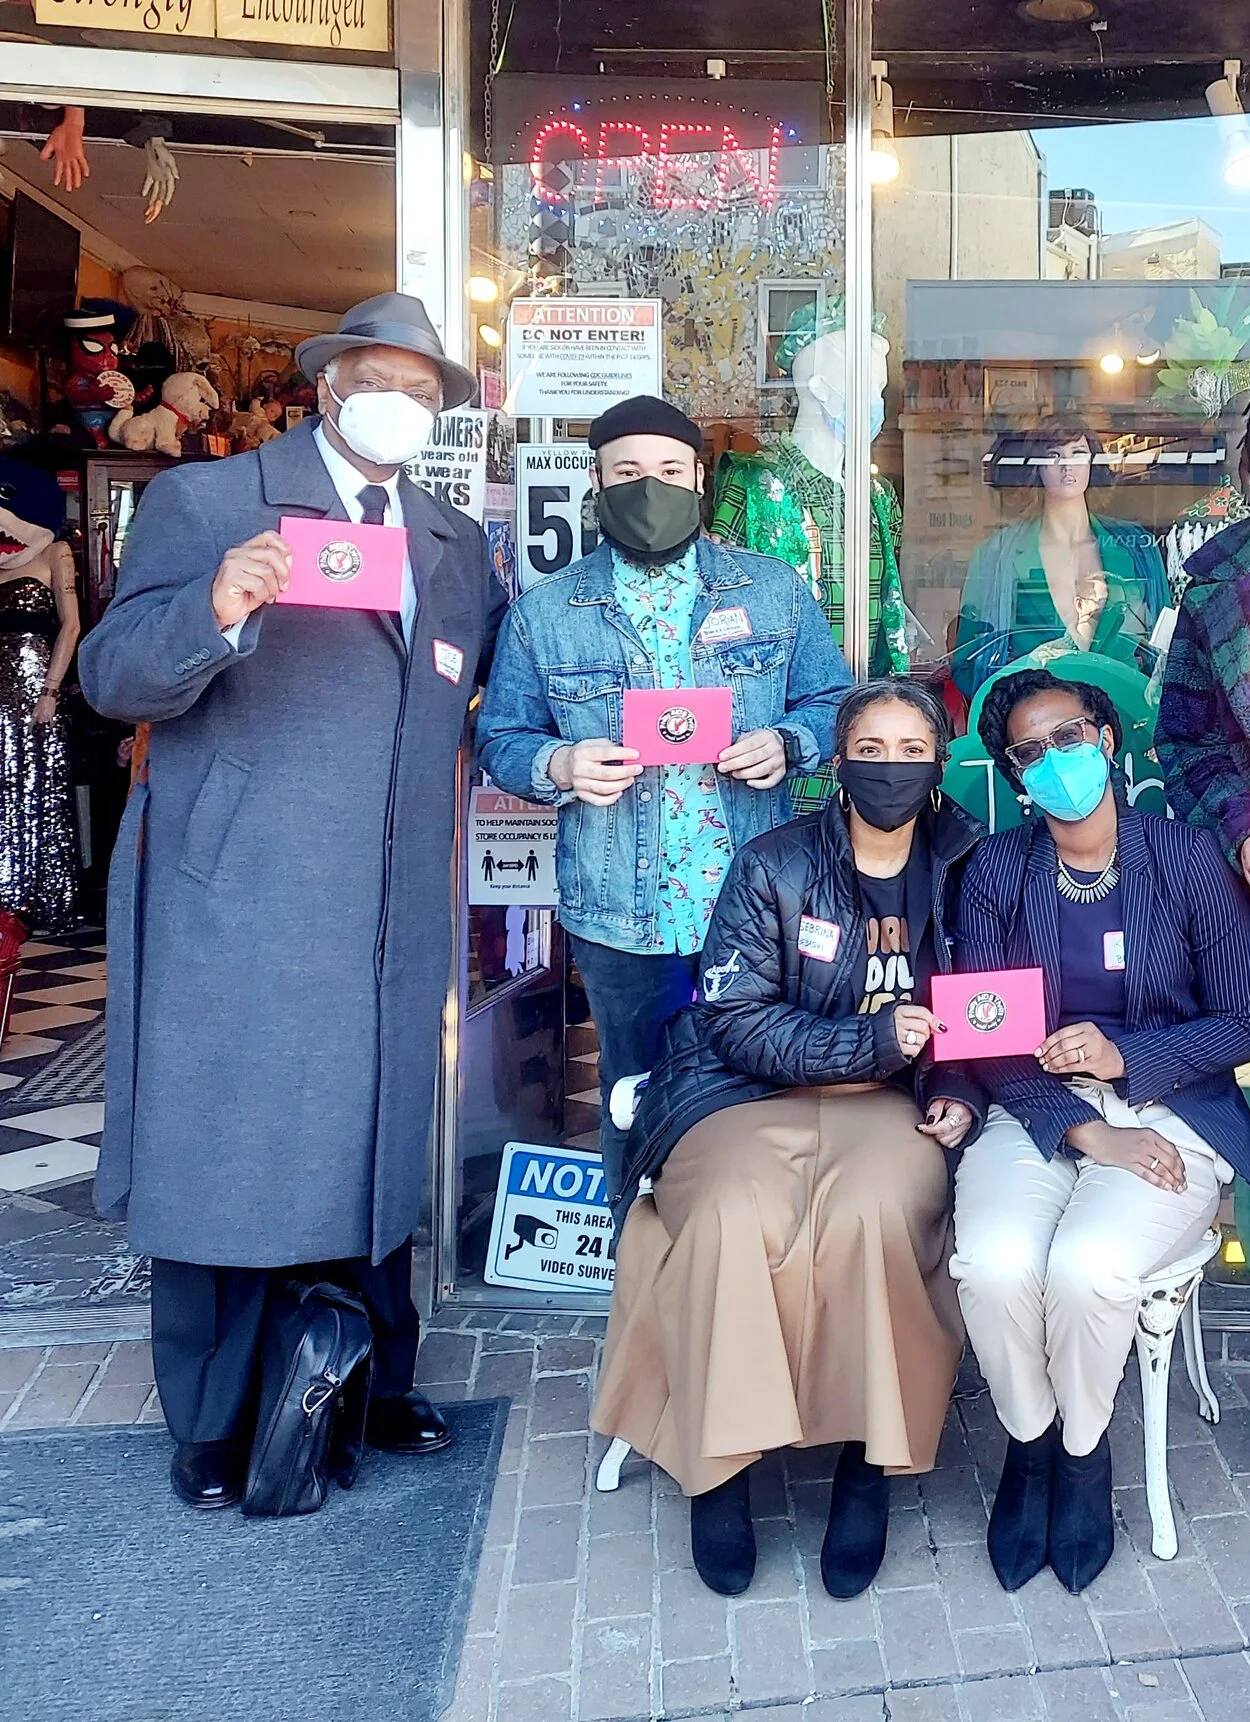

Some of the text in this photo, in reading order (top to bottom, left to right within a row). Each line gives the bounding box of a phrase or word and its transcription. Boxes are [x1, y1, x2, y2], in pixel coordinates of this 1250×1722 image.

[531, 121, 782, 209] OPEN
[532, 307, 635, 323] ATTENTION
[522, 329, 645, 342] DO NOT ENTER!
[420, 450, 479, 463] years old
[526, 456, 596, 470] MAX OCCUP
[425, 465, 472, 480] wear
[703, 611, 744, 630] JORIAN
[505, 819, 540, 827] MAINTAIN
[475, 832, 498, 840] STORE
[498, 832, 541, 840] OCCUPANCY
[543, 832, 549, 840] IS
[520, 1159, 609, 1203] NOT
[556, 1209, 613, 1230] THIS AREA
[575, 1234, 602, 1259] 24
[540, 1259, 616, 1281] VIDEO SURVE
